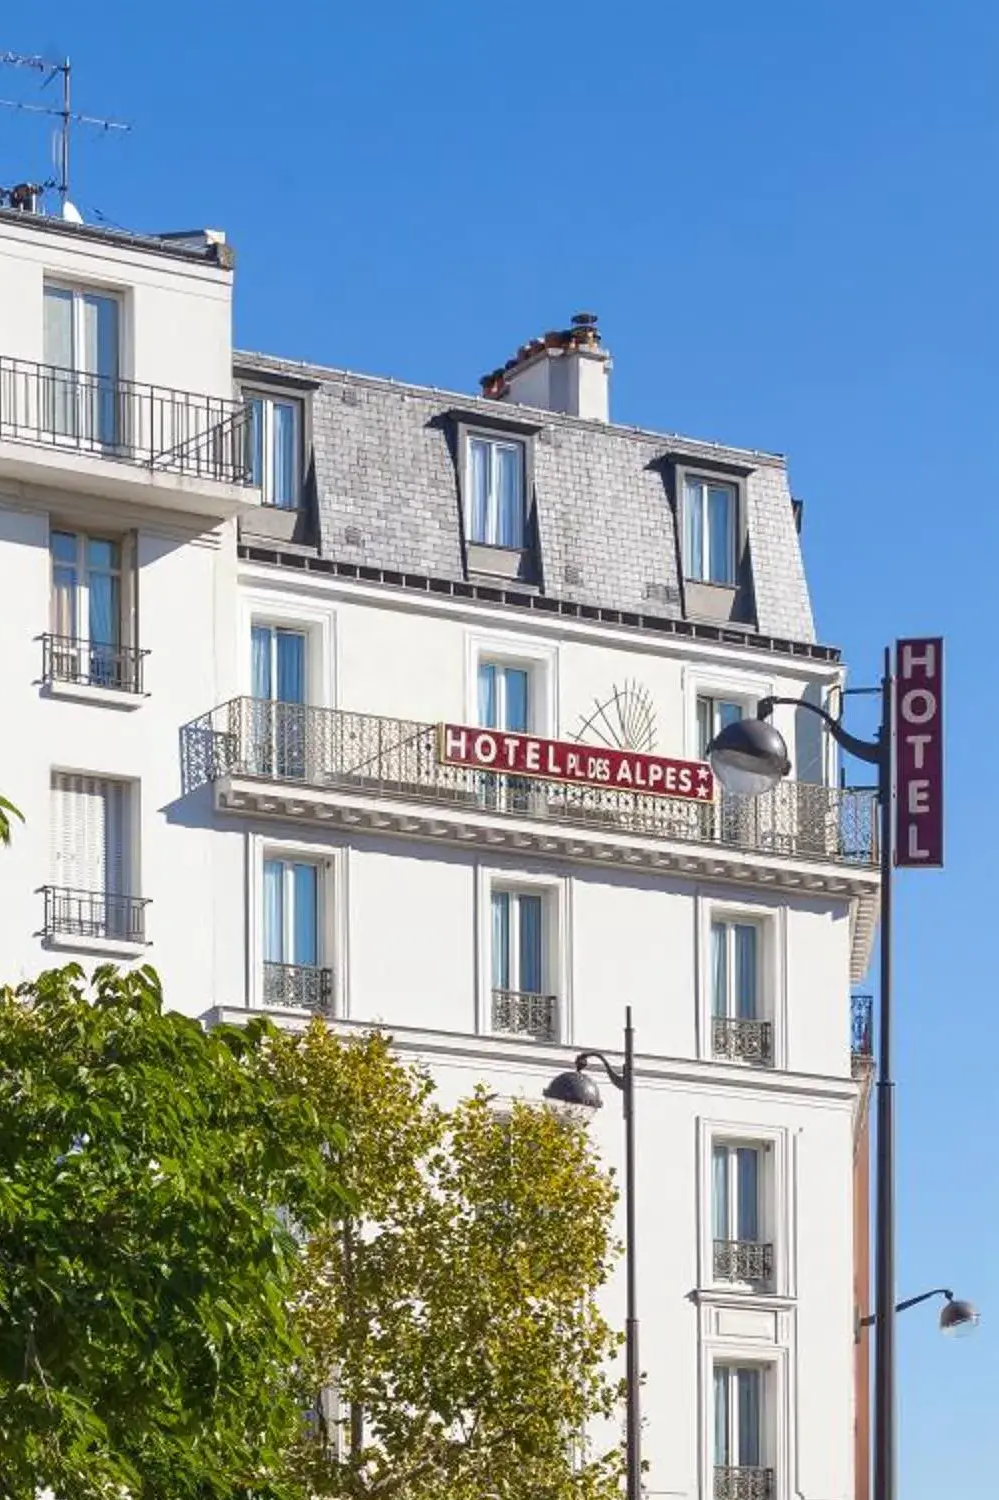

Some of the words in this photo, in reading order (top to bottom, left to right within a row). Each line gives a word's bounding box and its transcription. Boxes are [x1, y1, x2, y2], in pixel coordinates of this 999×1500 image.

[445, 728, 562, 774] HOTEL
[587, 757, 610, 781] DES
[616, 759, 692, 793] ALPES
[902, 644, 937, 858] HOTEL
